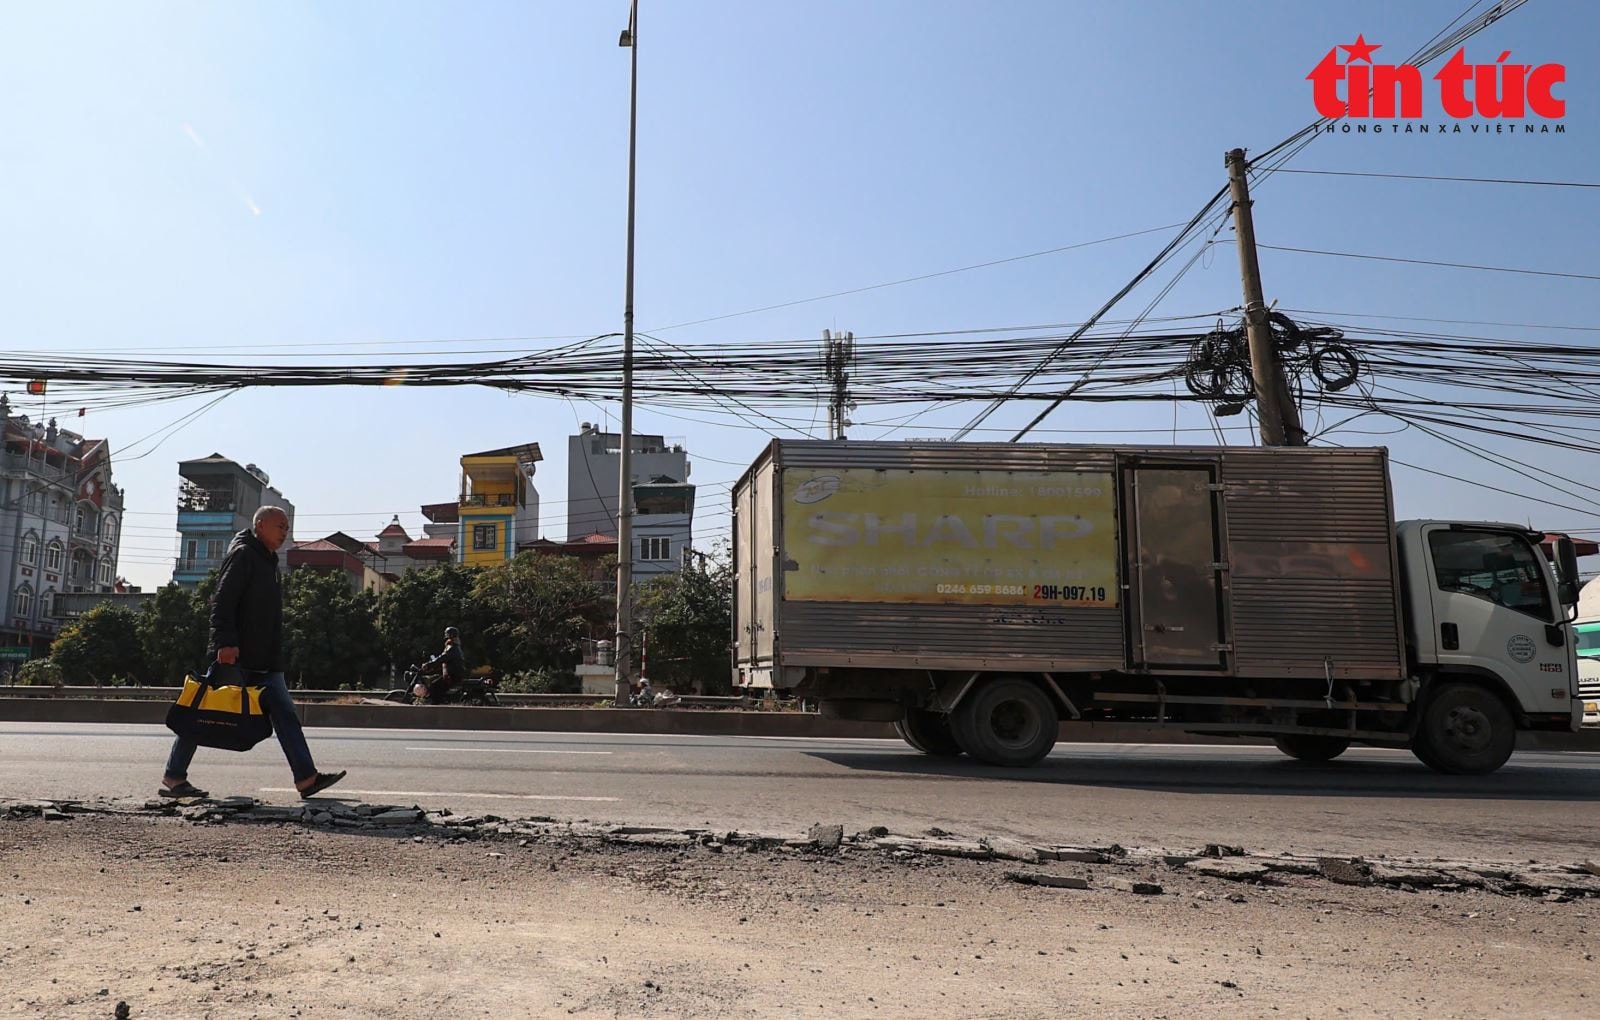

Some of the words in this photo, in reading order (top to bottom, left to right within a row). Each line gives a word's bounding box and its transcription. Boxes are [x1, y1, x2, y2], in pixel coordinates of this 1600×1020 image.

[807, 511, 1095, 551] SHARP
[936, 583, 966, 594] 0246
[969, 584, 992, 595] 659
[995, 584, 1024, 596] 8686
[1033, 585, 1106, 602] 29H-097.19
